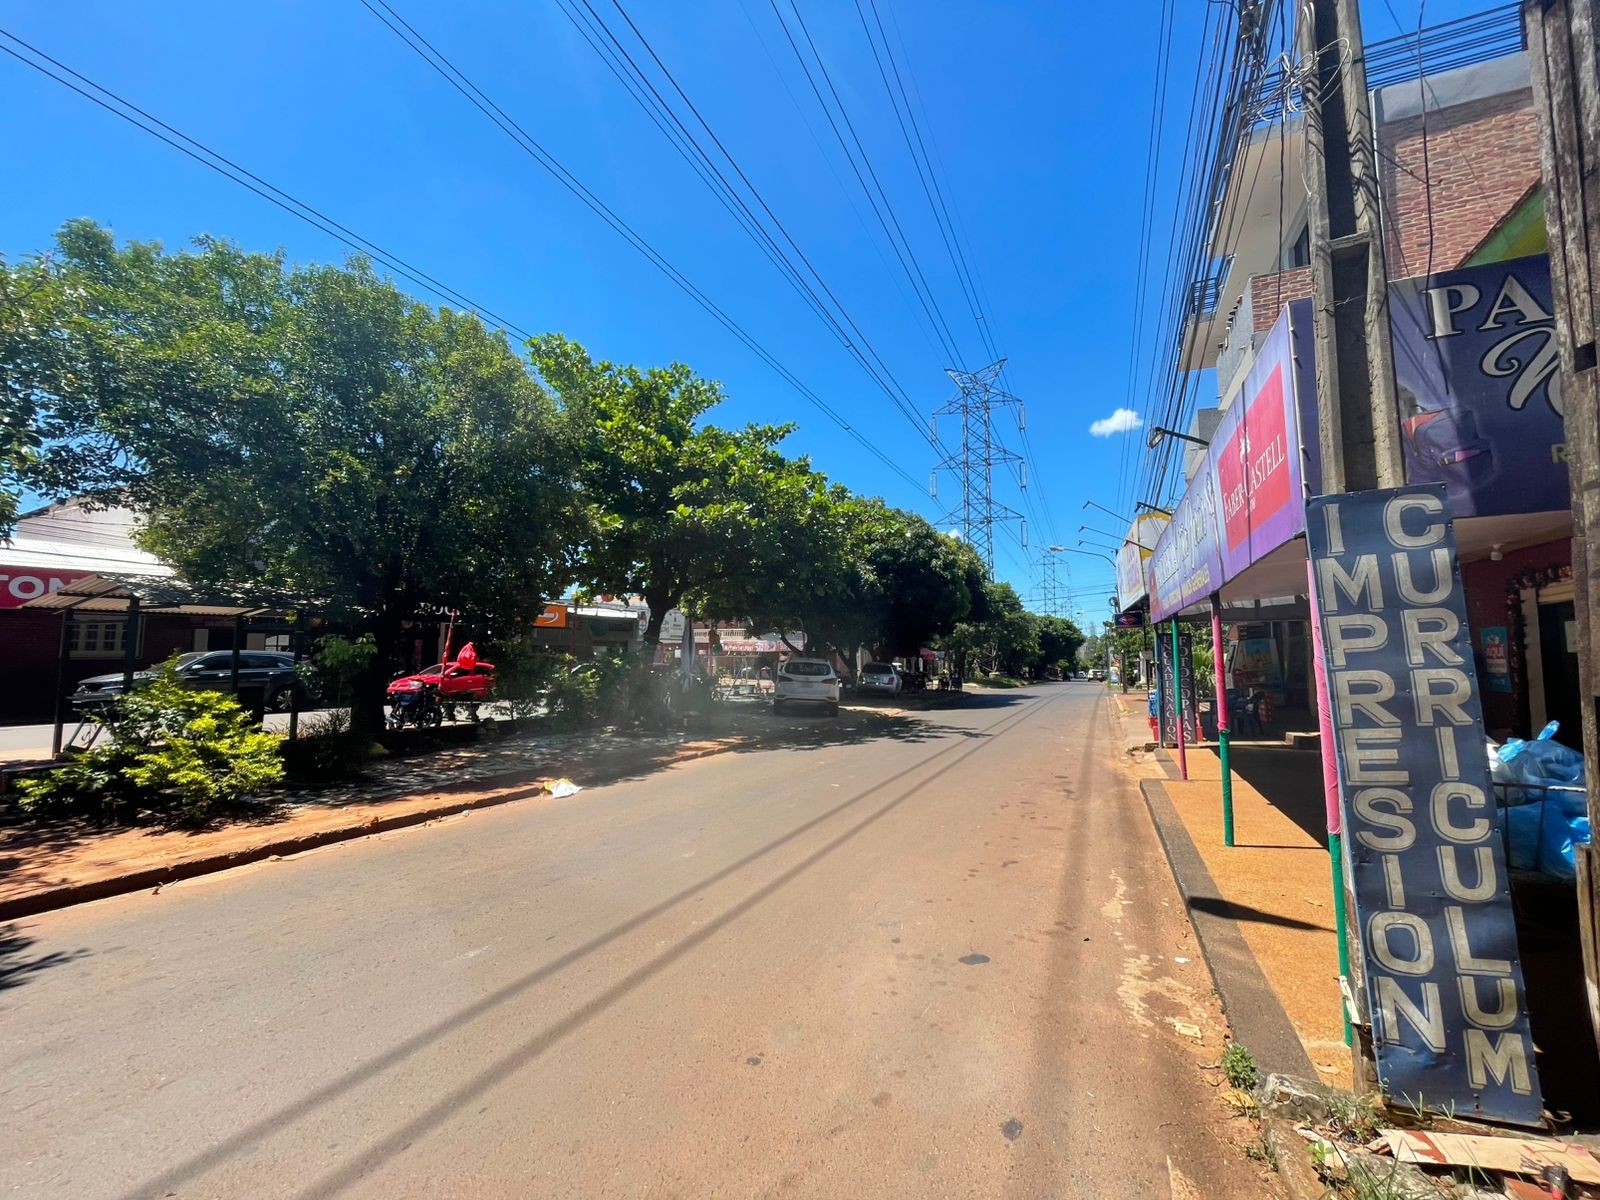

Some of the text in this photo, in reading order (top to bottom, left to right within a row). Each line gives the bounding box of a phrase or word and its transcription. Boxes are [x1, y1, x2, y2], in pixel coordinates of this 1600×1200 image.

[1179, 636, 1192, 741] FOTOCOPIAS
[1316, 503, 1446, 1053] IMPRESION
[1383, 494, 1531, 1096] CURRICULUM
